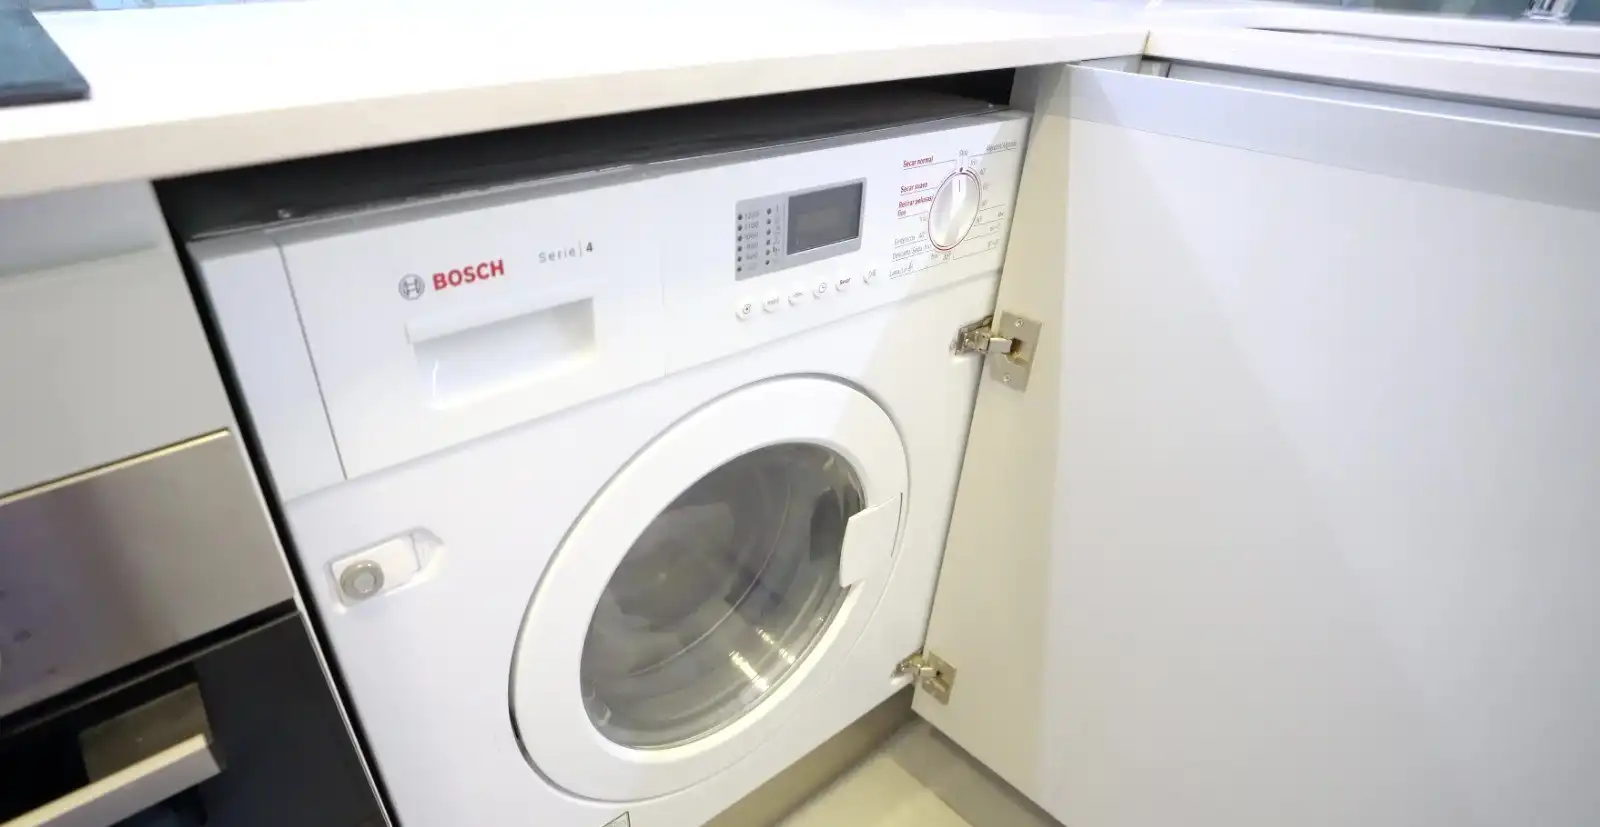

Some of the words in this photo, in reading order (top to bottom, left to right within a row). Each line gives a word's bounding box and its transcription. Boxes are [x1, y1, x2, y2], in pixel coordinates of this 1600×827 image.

[903, 159, 916, 168] Secar
[917, 155, 934, 165] normal
[900, 183, 914, 193] Secar
[586, 242, 594, 253] 4
[432, 259, 505, 291] BOSCH
